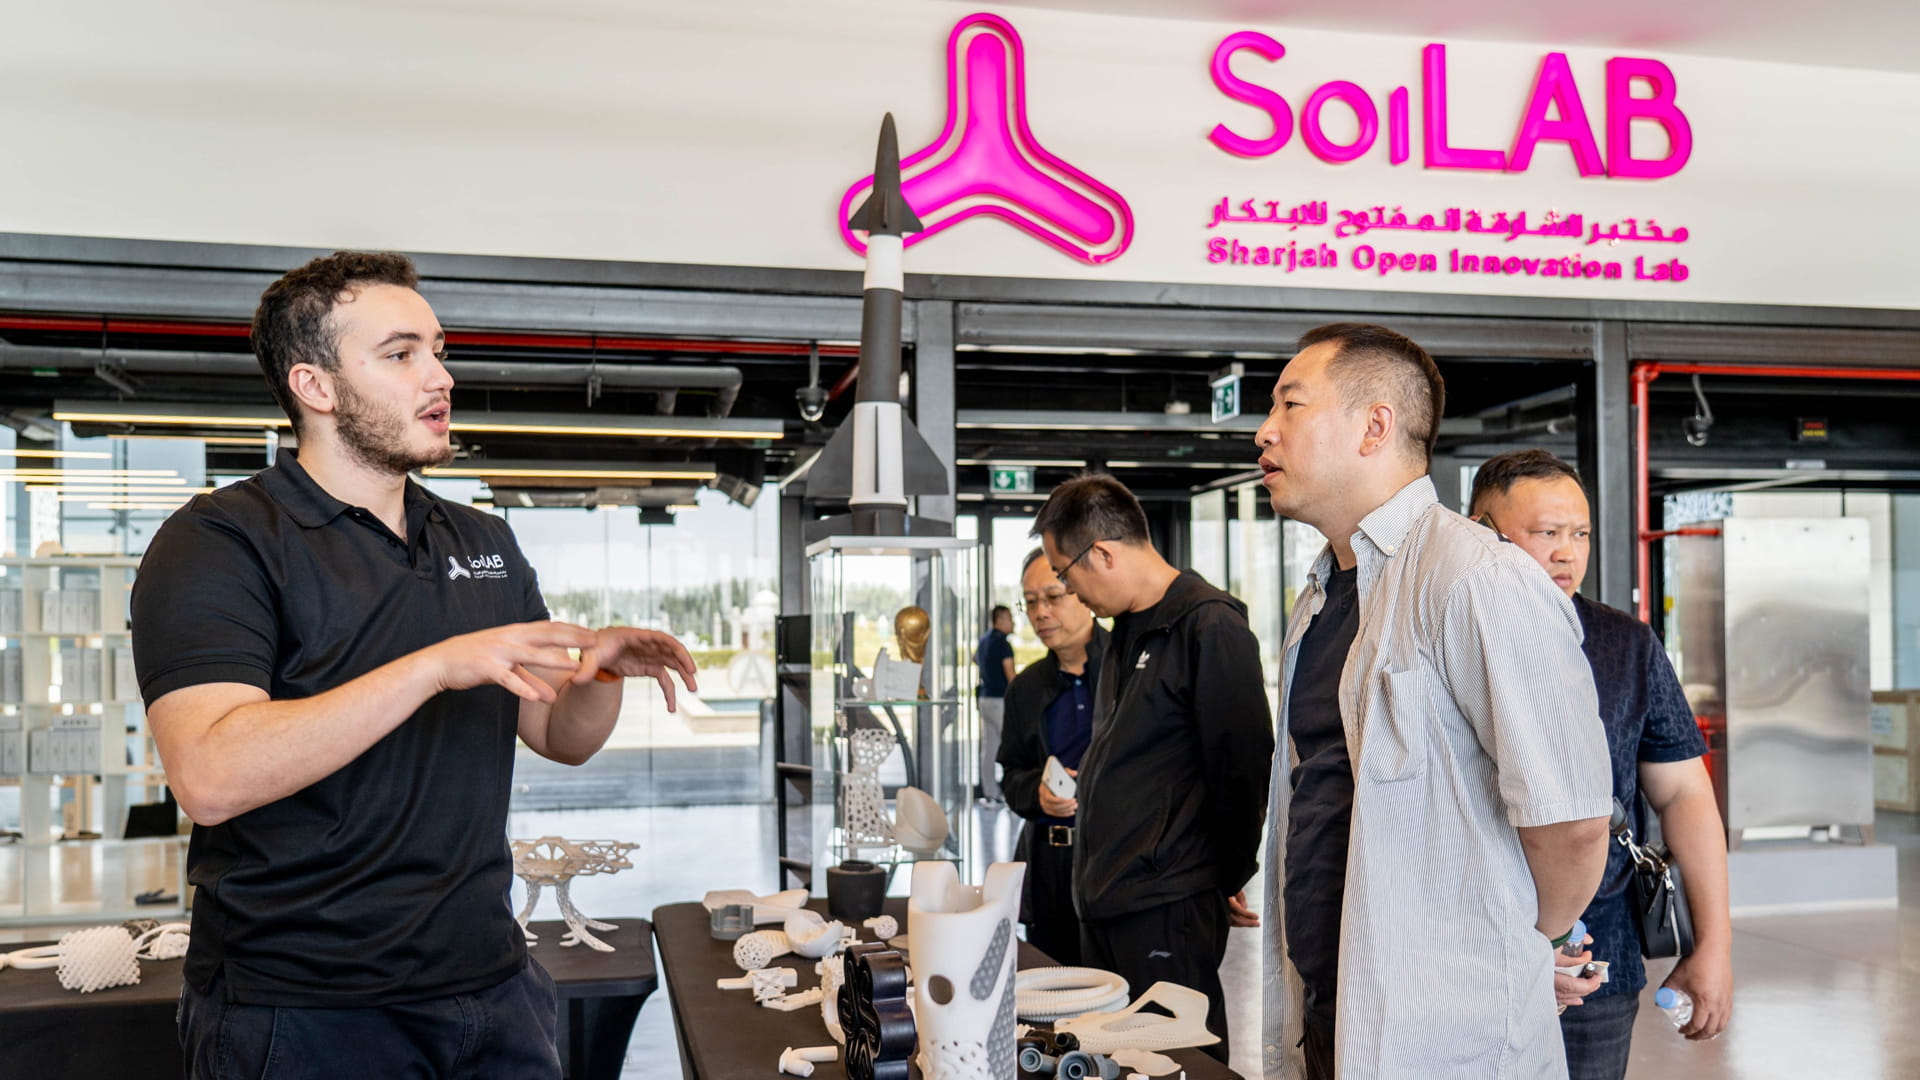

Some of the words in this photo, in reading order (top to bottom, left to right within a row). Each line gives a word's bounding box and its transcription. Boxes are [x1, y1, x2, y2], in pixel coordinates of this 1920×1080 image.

[1207, 196, 1329, 232] للابتكار
[1334, 205, 1463, 239] المفتوح
[1465, 207, 1584, 242] الشارقة
[1586, 217, 1690, 246] مختبر
[1207, 236, 1338, 273] Sharjah
[1351, 244, 1438, 276] Open
[1450, 248, 1623, 280] Innovation
[1634, 255, 1690, 283] Lab
